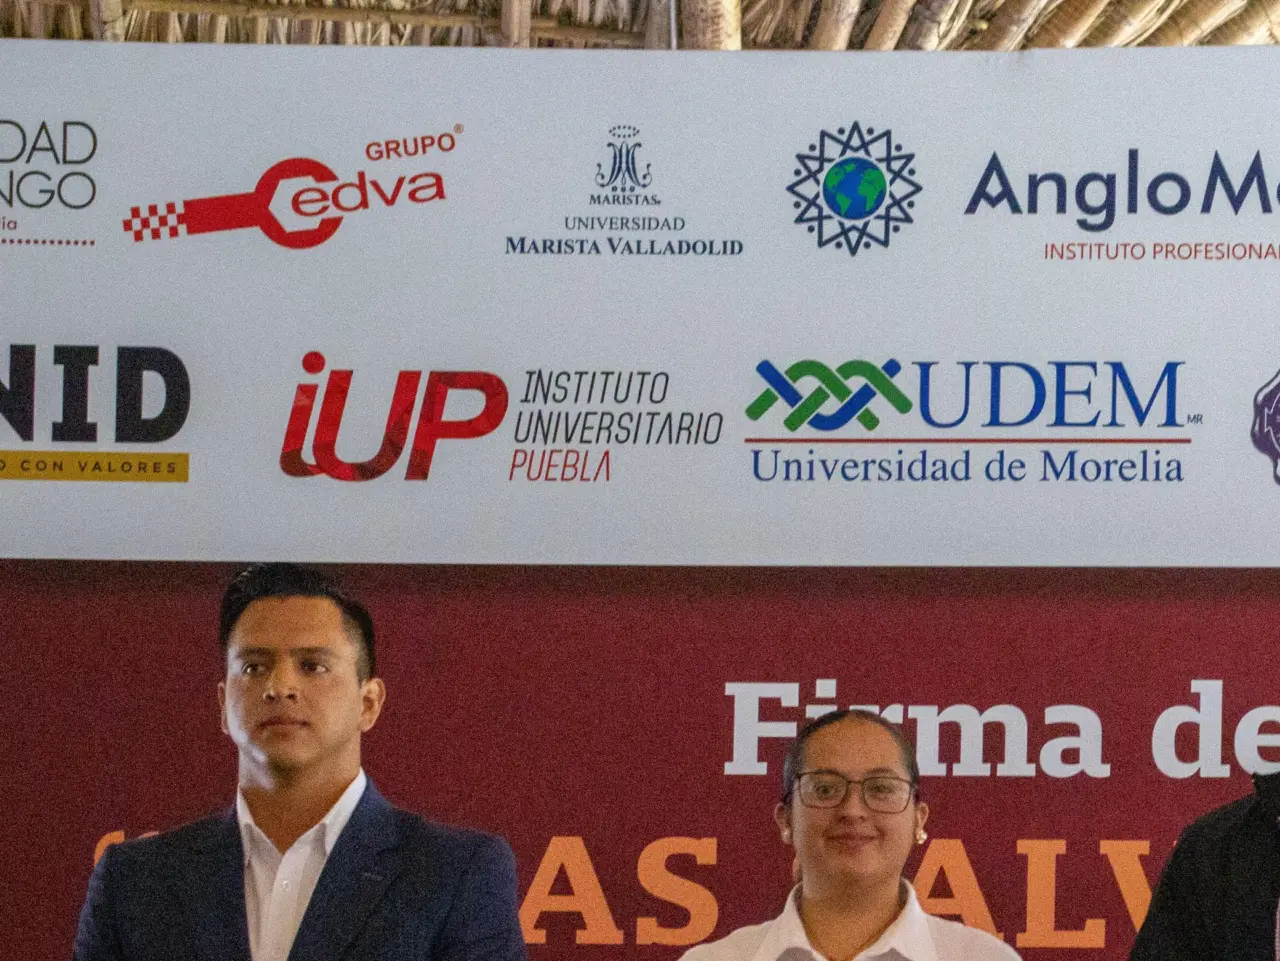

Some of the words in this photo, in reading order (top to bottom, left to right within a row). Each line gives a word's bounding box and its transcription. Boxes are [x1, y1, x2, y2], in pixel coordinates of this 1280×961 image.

[365, 132, 456, 161] GRUPO
[589, 194, 658, 205] MARISTAS
[564, 216, 686, 231] UNIVERSIDAD
[505, 236, 602, 255] MARISTA
[606, 237, 744, 256] VALLADOLID
[1044, 242, 1146, 260] INSTITUTO
[520, 369, 670, 404] INSTITUTO
[911, 360, 1186, 429] UDEM
[280, 350, 510, 482] iUP
[514, 409, 724, 445] UNIVERSITARIO
[20, 460, 65, 472] CON
[78, 461, 178, 474] VALORES
[508, 449, 612, 482] PUEBLA
[751, 448, 972, 482] Universidad
[985, 449, 1026, 482] de
[1039, 449, 1185, 482] Morelia
[724, 678, 1111, 778] Fma
